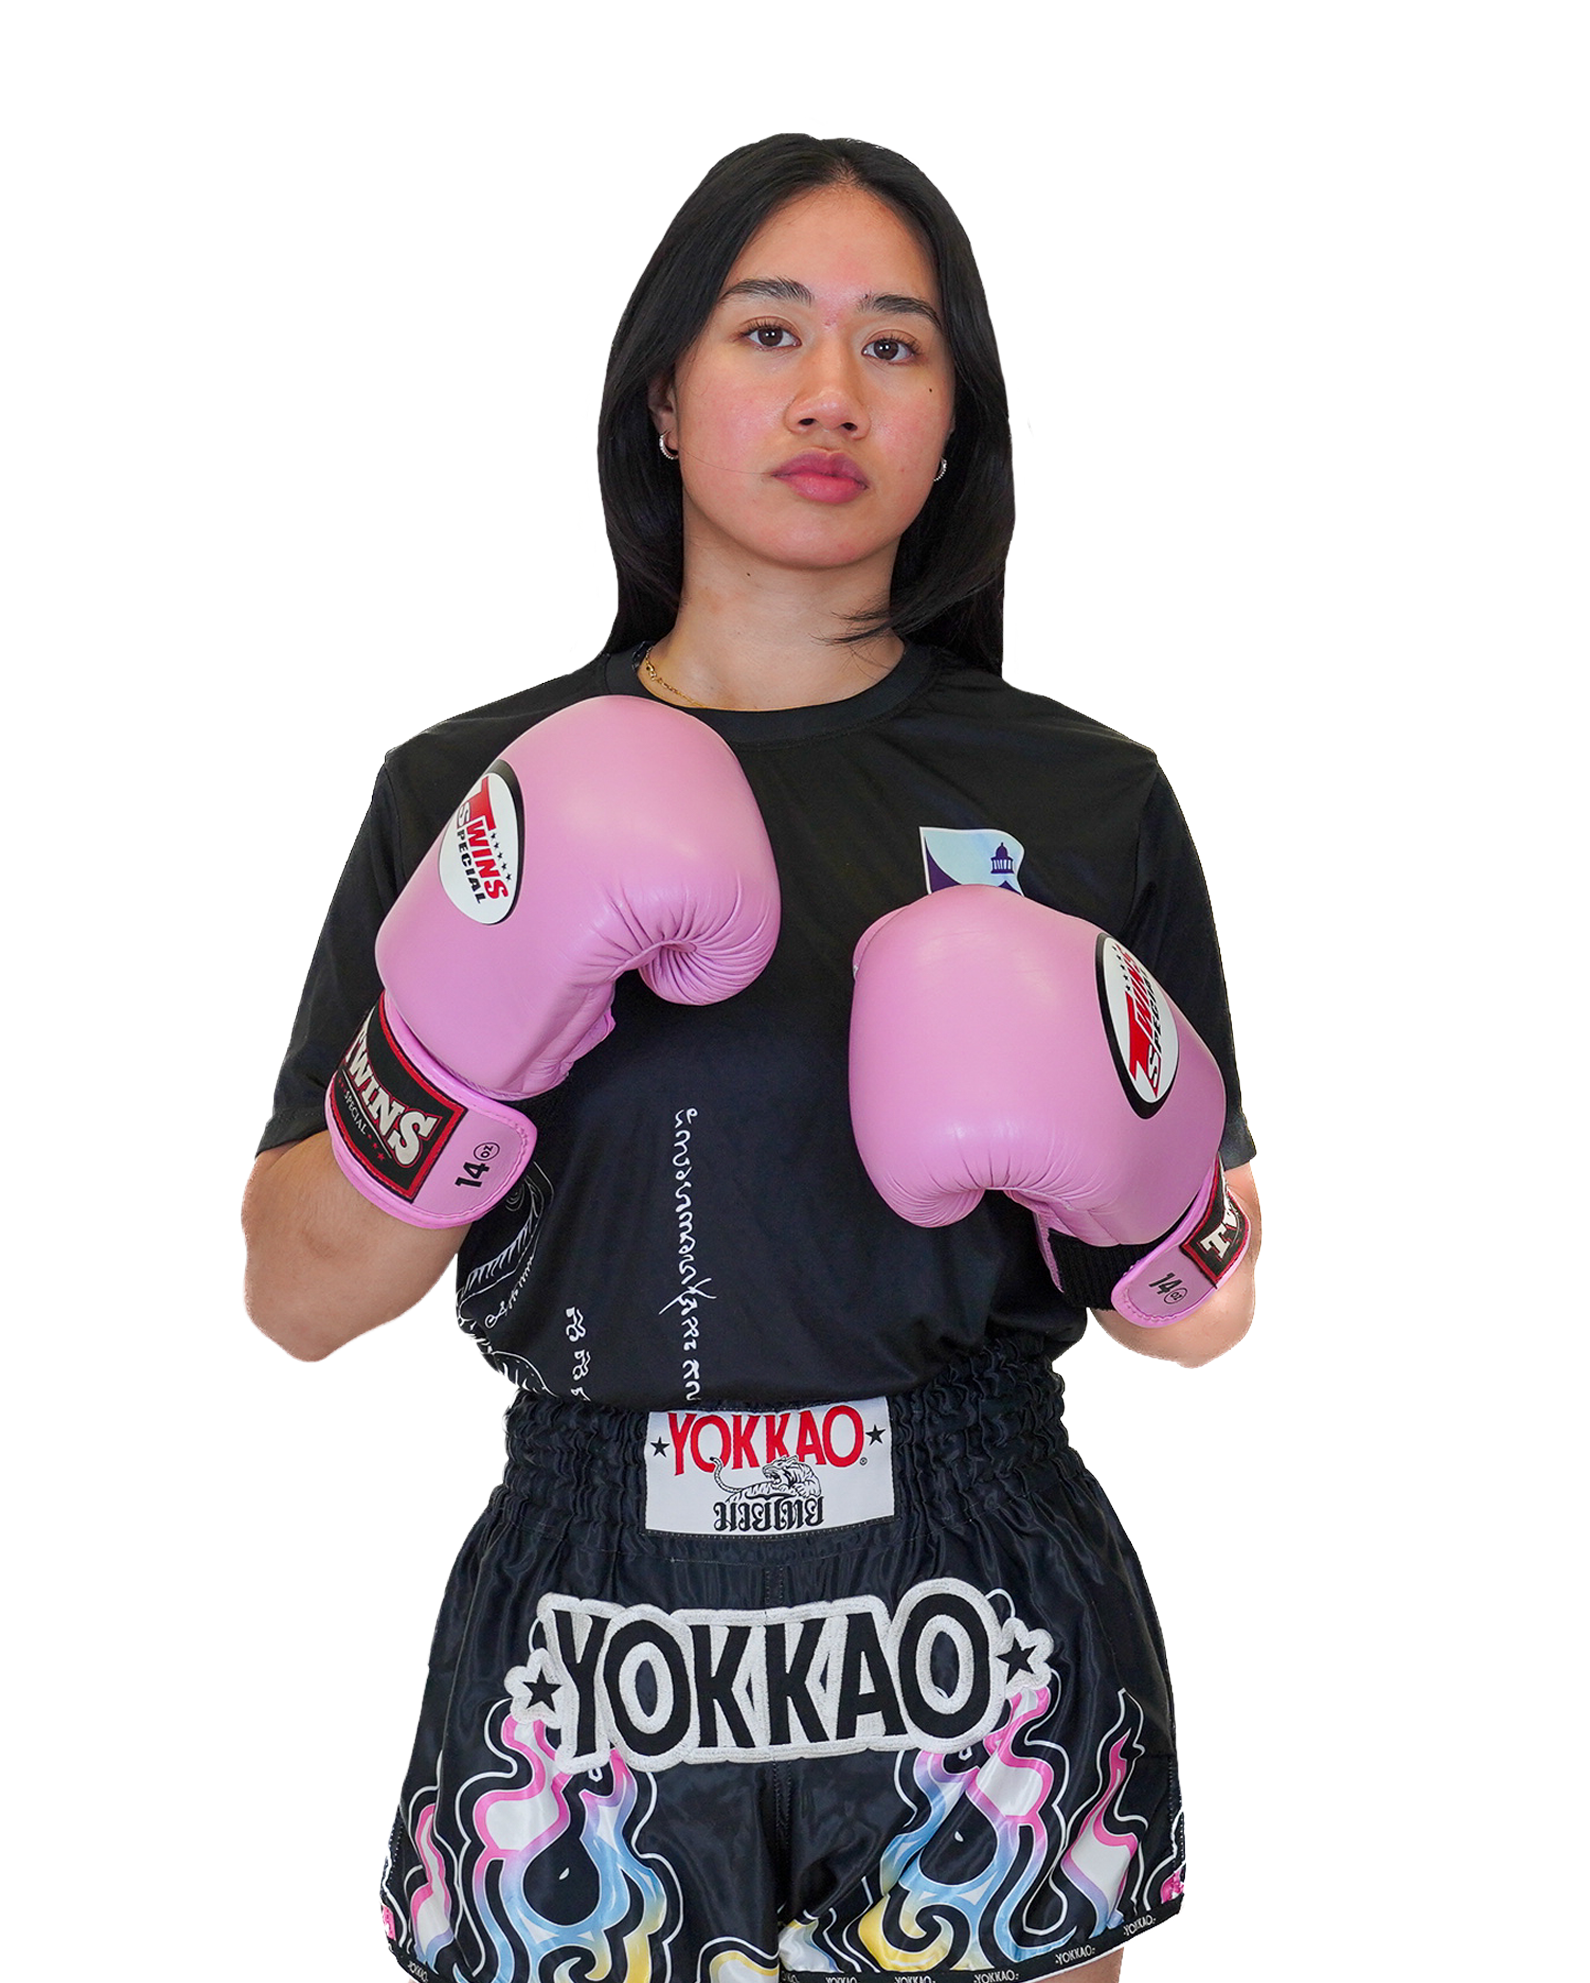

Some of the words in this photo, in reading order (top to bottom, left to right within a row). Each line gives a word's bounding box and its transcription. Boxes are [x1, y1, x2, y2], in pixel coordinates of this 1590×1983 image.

[457, 776, 509, 899] TWINS
[457, 801, 487, 904] SPECIAL
[343, 1090, 367, 1135] SPECIAL
[455, 1162, 490, 1188] 14
[1149, 1272, 1182, 1295] 14
[668, 1405, 865, 1476] YOKKAO
[713, 1496, 825, 1532] มวยไทย
[552, 1593, 989, 1757] YOKKAO
[1056, 1945, 1092, 1965] YOKKAO
[975, 1969, 1016, 1983] YOKKAO
